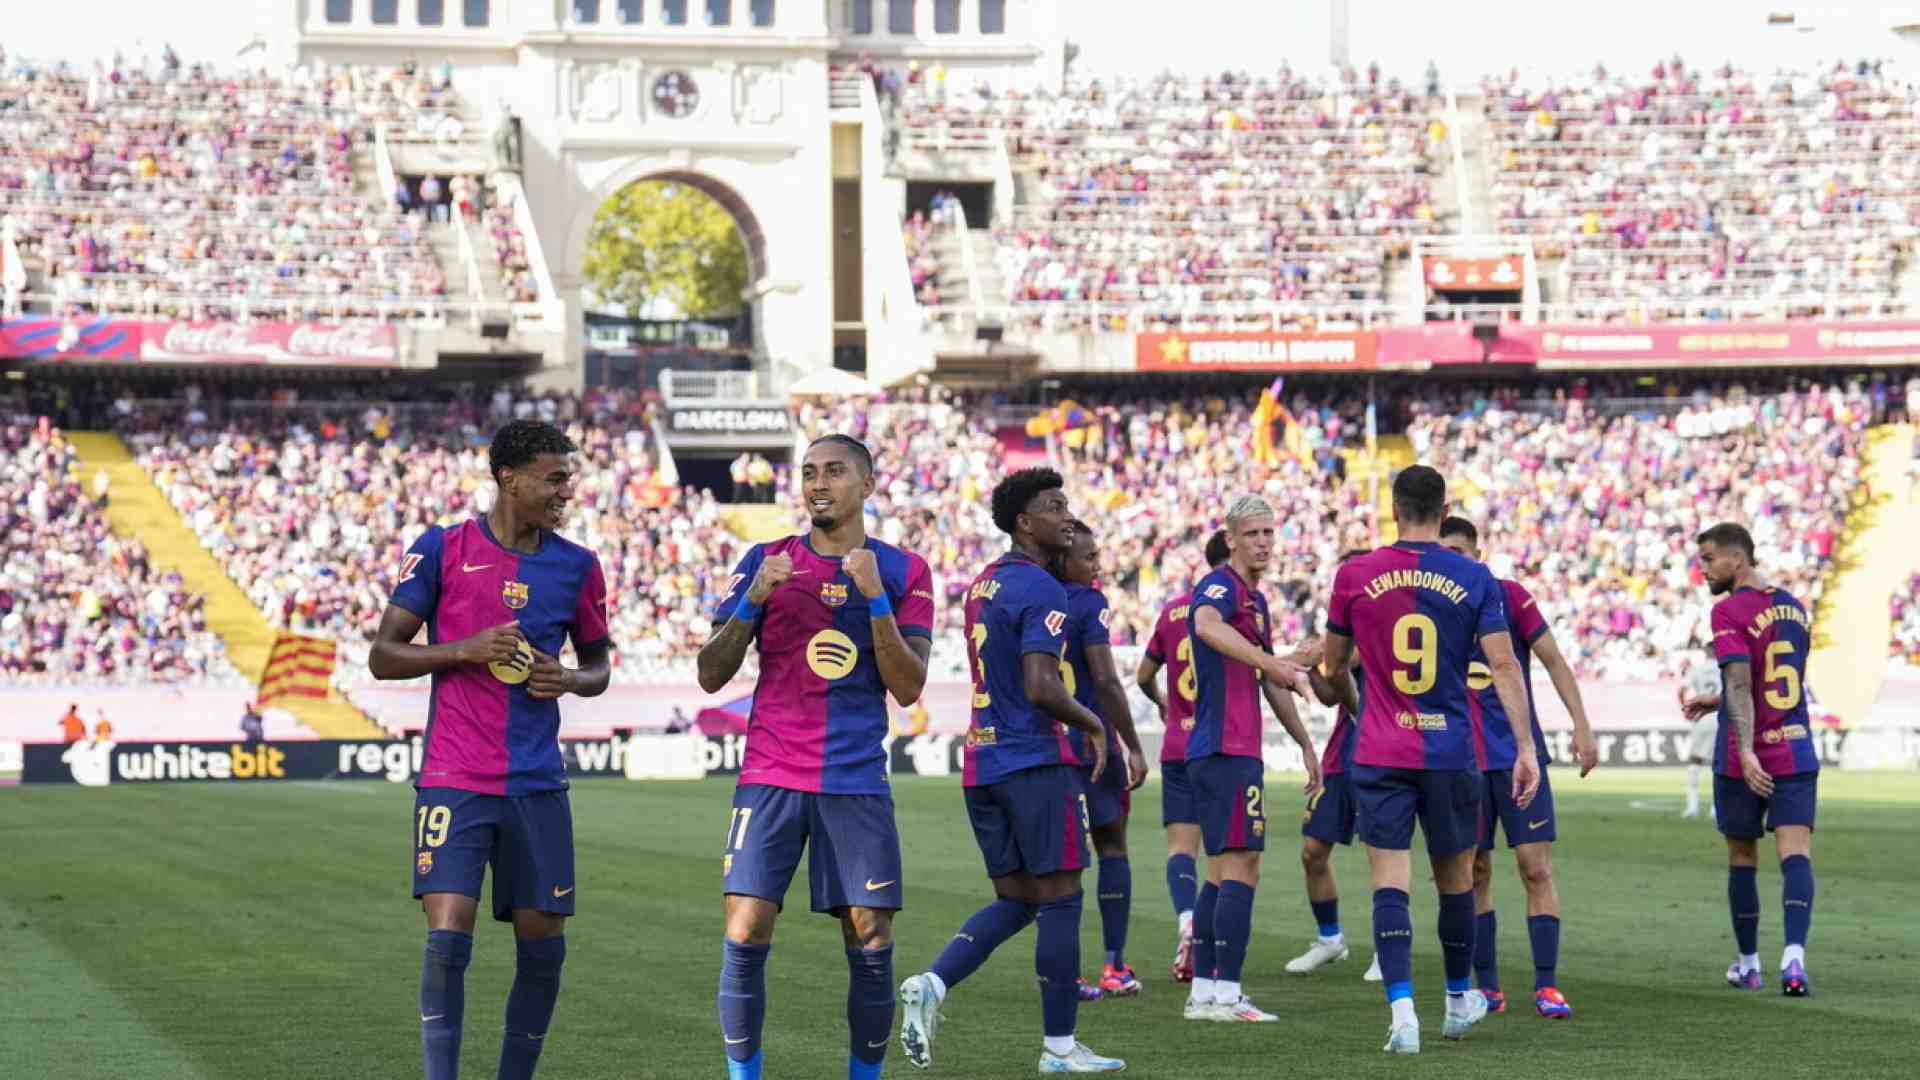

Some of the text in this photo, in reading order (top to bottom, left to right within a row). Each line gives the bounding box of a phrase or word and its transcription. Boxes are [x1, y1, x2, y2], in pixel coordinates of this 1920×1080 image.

[673, 409, 787, 431] BARCELONA
[1363, 569, 1468, 604] LEWANDOWSKI
[1392, 613, 1438, 695] 9
[1764, 640, 1800, 710] 5
[117, 743, 286, 779] whitebit
[1622, 730, 1666, 763] at
[1247, 785, 1264, 817] 2
[418, 805, 452, 849] 19
[726, 807, 753, 850] 11
